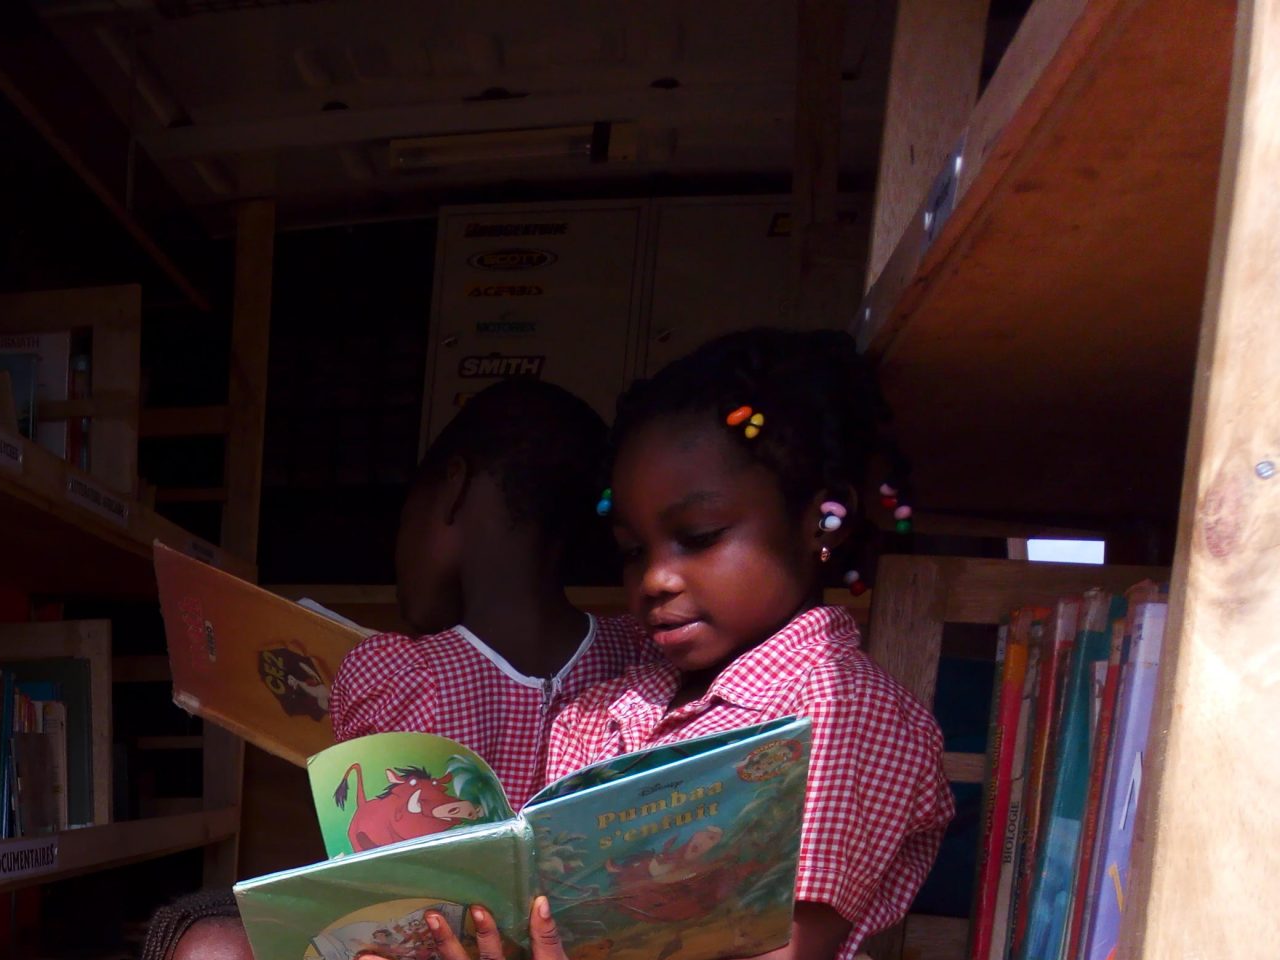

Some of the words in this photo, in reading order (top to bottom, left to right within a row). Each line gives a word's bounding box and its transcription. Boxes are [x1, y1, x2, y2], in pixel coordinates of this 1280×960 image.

[463, 358, 540, 376] SMITH
[262, 652, 287, 695] CE2
[596, 778, 725, 831] Pumbaa
[637, 779, 685, 798] Disney
[598, 800, 720, 850] s'enfuit
[1001, 800, 1021, 864] BIOLOGIE
